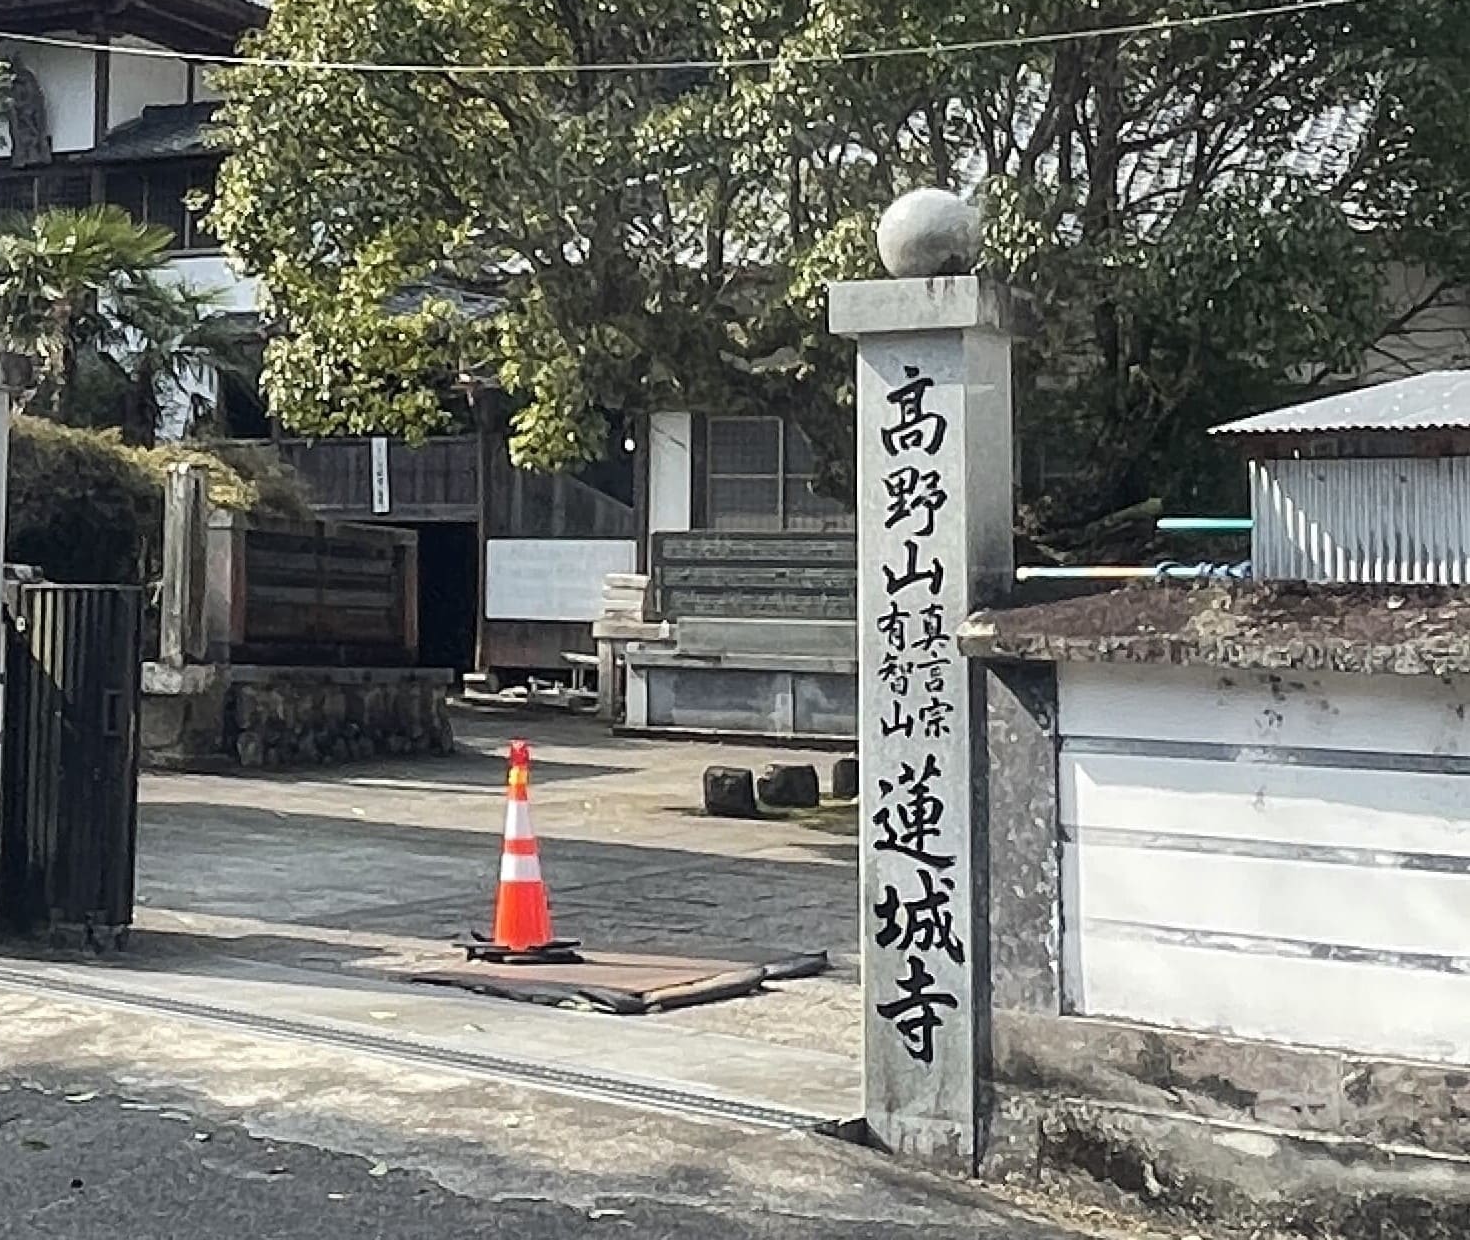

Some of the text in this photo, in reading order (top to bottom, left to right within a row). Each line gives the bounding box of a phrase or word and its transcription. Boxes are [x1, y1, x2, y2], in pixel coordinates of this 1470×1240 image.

[877, 601, 914, 739] 有智山
[911, 603, 954, 739] 真言宗
[872, 753, 966, 1065] 蓮城寺
